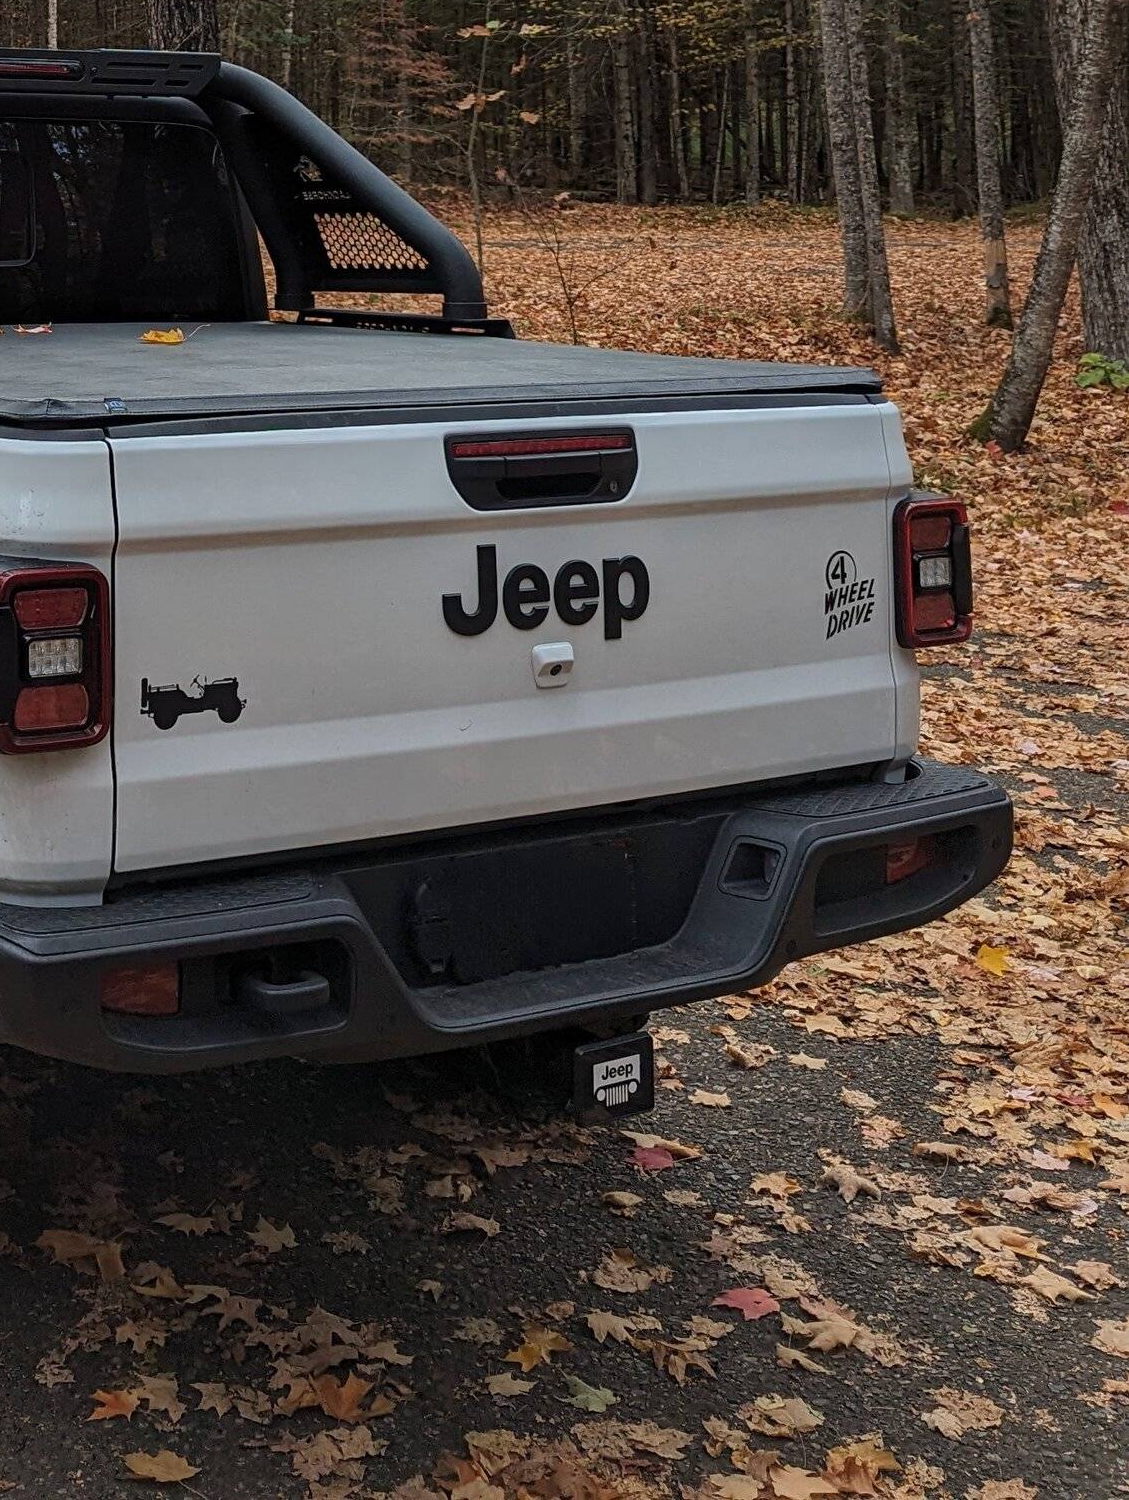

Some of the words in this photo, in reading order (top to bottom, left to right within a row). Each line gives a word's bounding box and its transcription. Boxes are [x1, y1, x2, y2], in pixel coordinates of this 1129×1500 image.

[831, 555, 847, 585] 4
[442, 543, 650, 640] Jeep
[825, 578, 875, 615] WHEEL
[826, 601, 875, 640] DRIVE
[601, 1063, 634, 1081] Jeep
